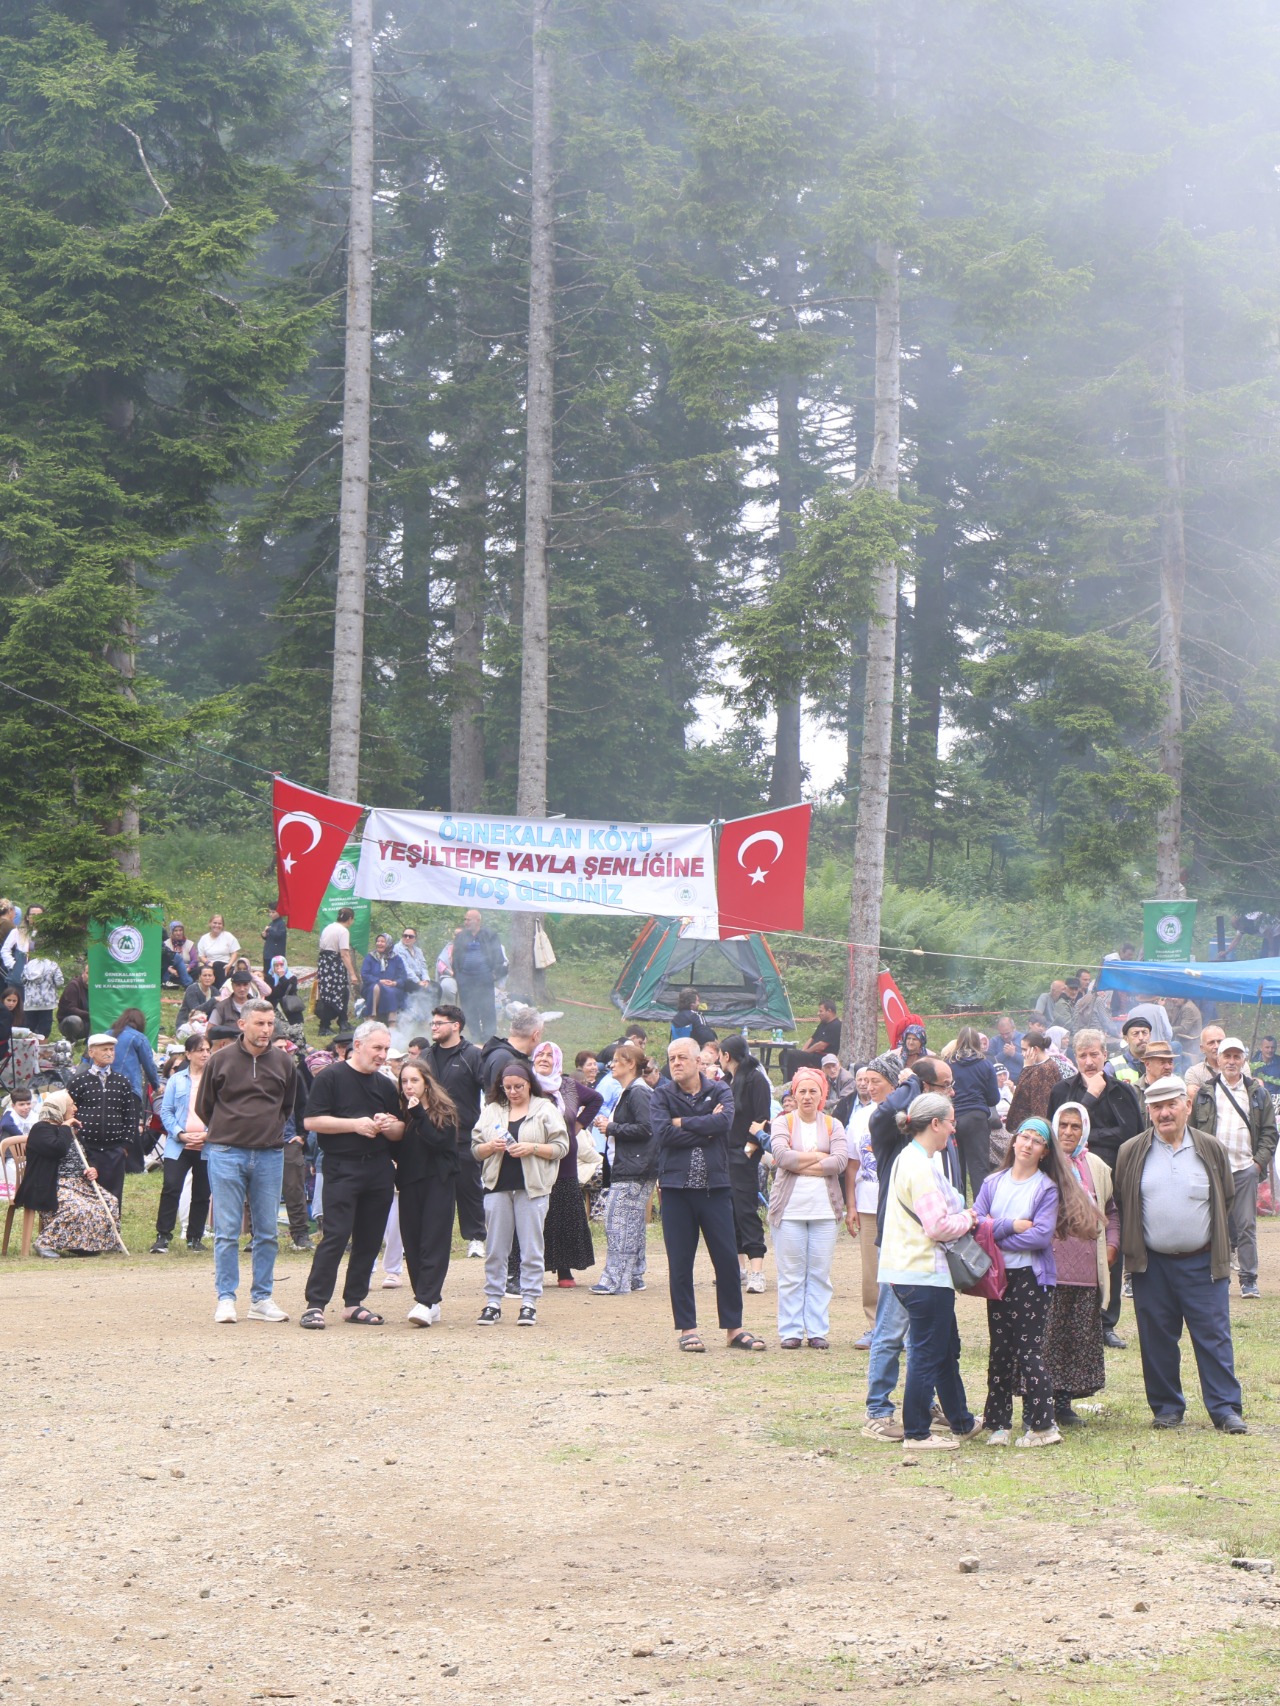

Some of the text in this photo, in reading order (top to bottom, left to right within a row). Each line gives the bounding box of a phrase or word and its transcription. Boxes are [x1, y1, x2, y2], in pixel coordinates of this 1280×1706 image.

[438, 815, 653, 852] ÖRNEKALAN KÖYÜ
[378, 839, 705, 881] YEŞİLTEPE YAYLA ŞENLİĞİNE
[458, 876, 623, 905] HOŞ GELDİNİZ
